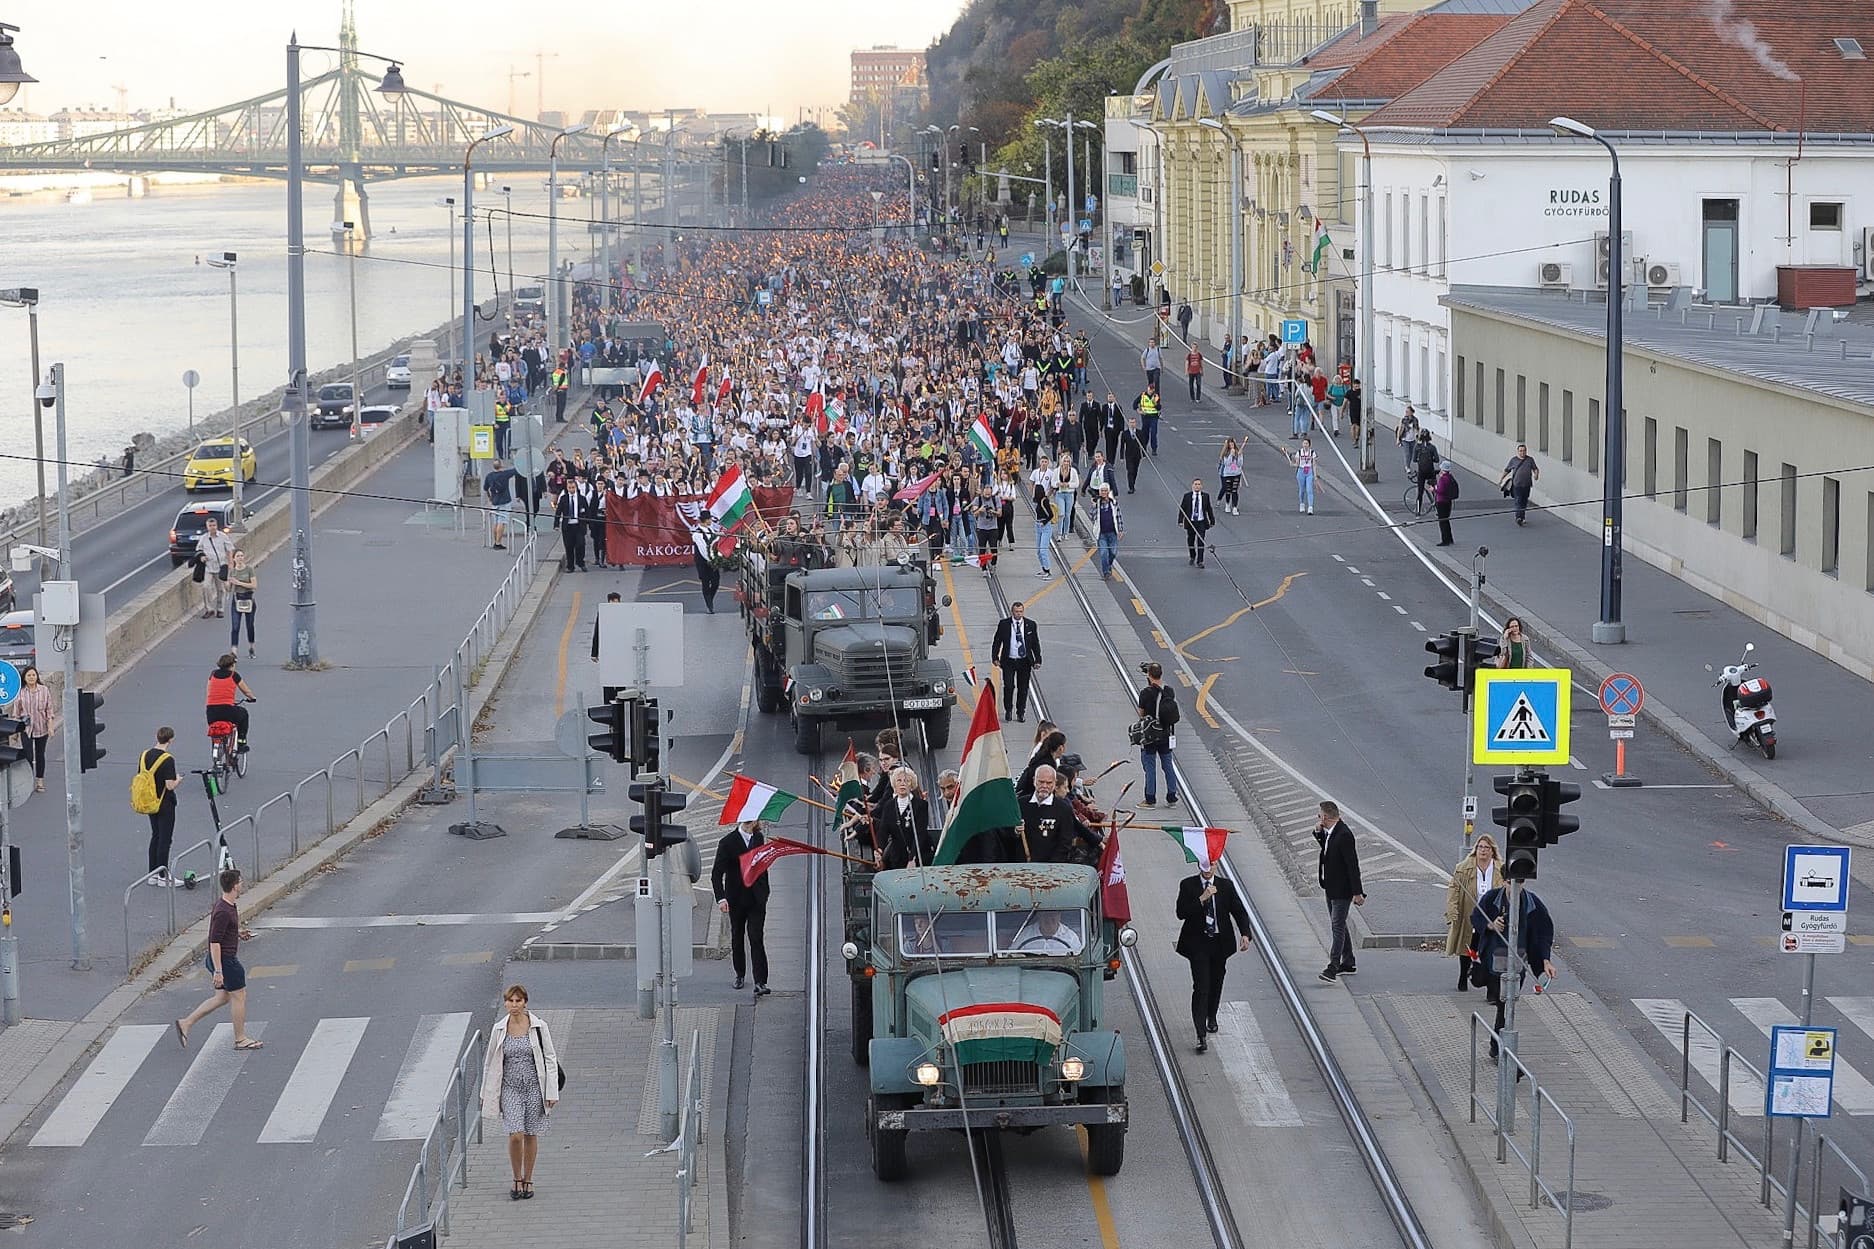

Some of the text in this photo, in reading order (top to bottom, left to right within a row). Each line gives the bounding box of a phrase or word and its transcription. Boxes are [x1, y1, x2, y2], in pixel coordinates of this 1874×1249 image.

[1550, 190, 1600, 204] RUDAS
[1288, 323, 1300, 340] P
[1809, 914, 1830, 922] Rudas
